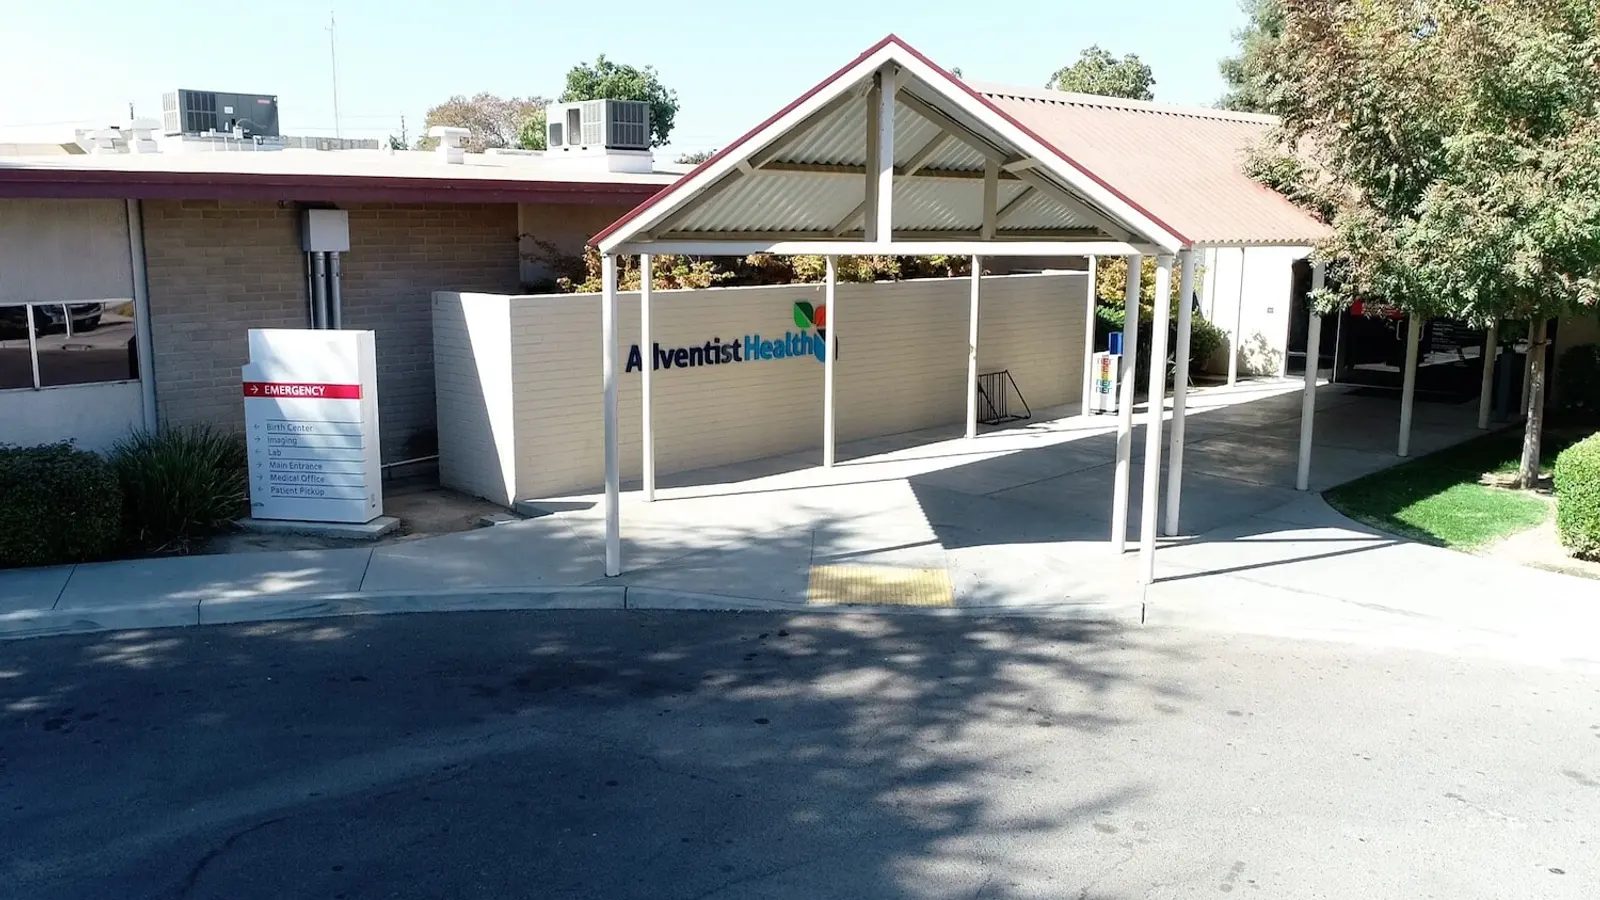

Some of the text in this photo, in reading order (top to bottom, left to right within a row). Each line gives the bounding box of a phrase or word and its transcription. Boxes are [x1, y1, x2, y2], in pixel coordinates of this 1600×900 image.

[264, 385, 326, 396] EMERGENCY
[266, 423, 313, 432] Birth Center
[267, 437, 298, 446] Imaging
[289, 462, 323, 470] Entrance
[270, 474, 325, 483] Medical Office
[270, 486, 325, 496] Patient Pickup
